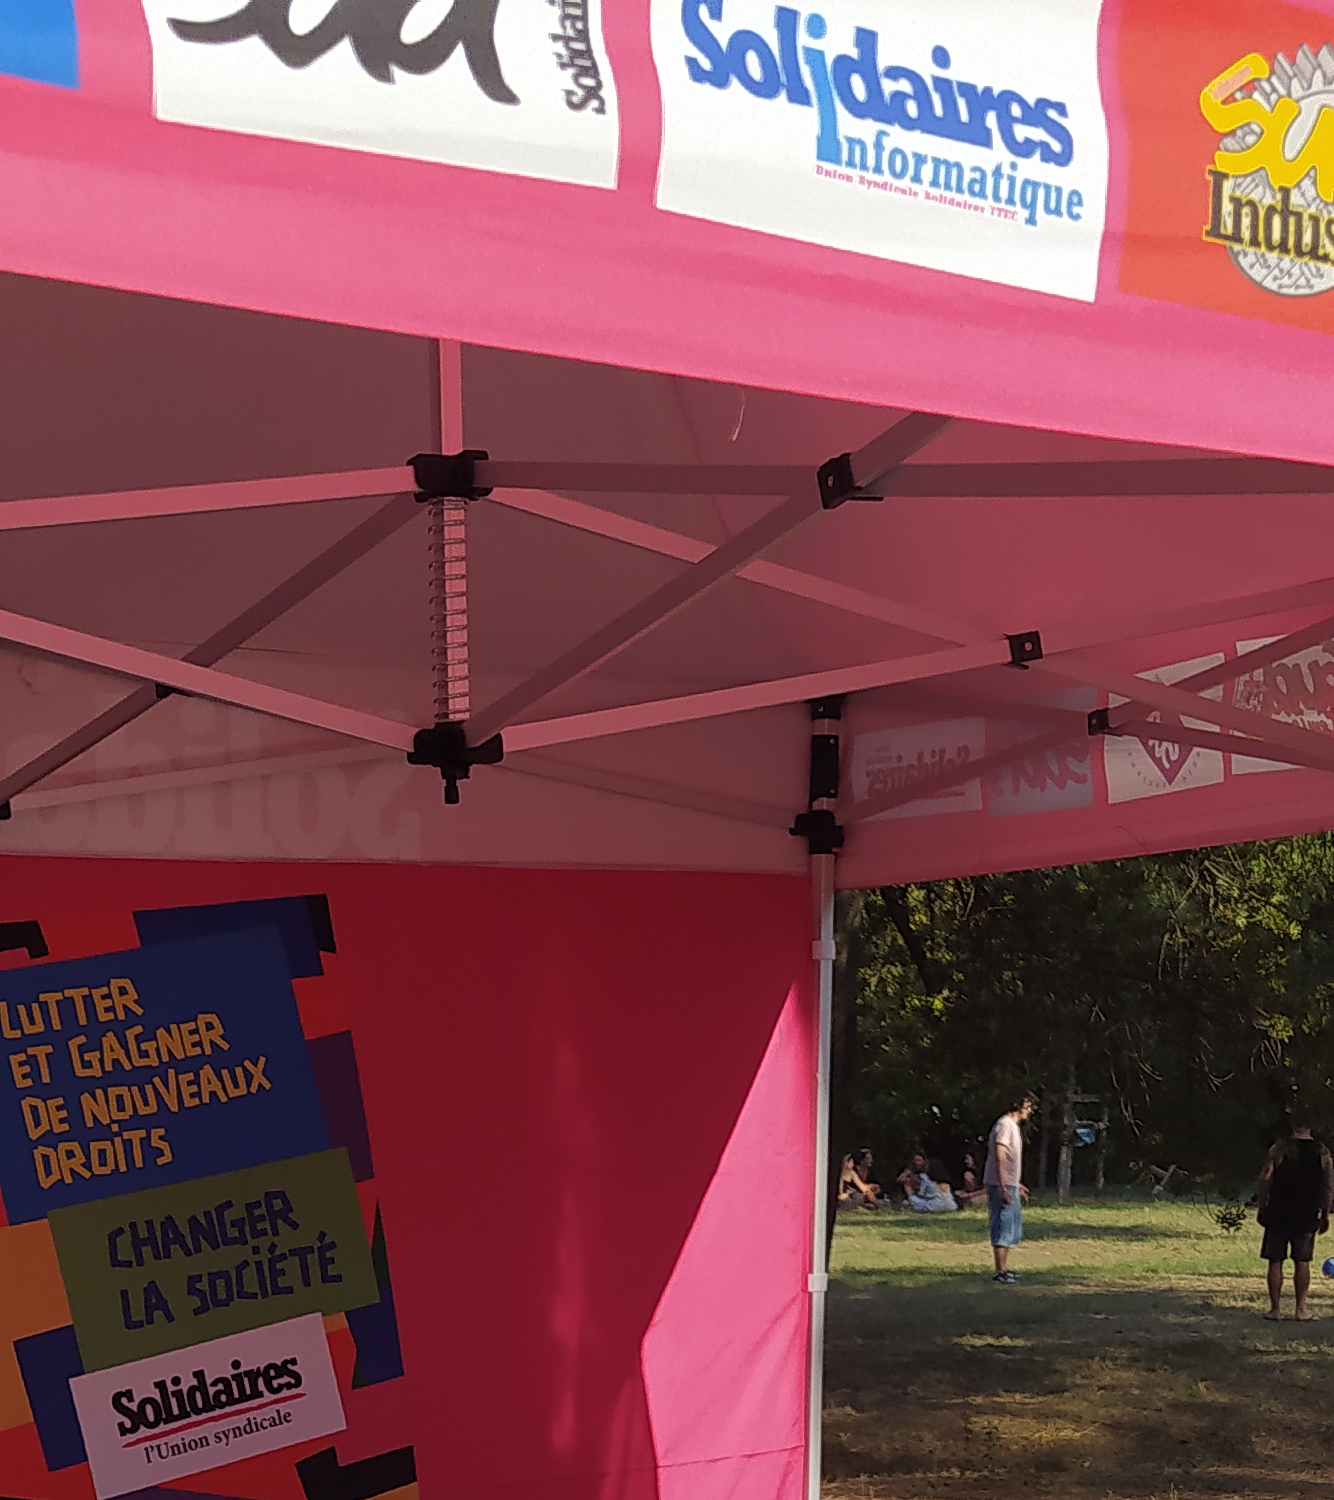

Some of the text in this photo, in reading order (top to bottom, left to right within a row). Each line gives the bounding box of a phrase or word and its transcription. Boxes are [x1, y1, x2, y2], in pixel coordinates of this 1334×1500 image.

[680, 0, 1074, 168] Solidaires
[815, 115, 1084, 227] Informatique
[10, 1014, 231, 1090] ET GAGNER
[22, 1056, 274, 1141] DE NOUVEAUX
[107, 1189, 300, 1270] CHANGER
[120, 1282, 173, 1331] LA
[111, 1354, 303, 1439] Solidaires
[144, 1406, 293, 1465] l'Union syndicale
